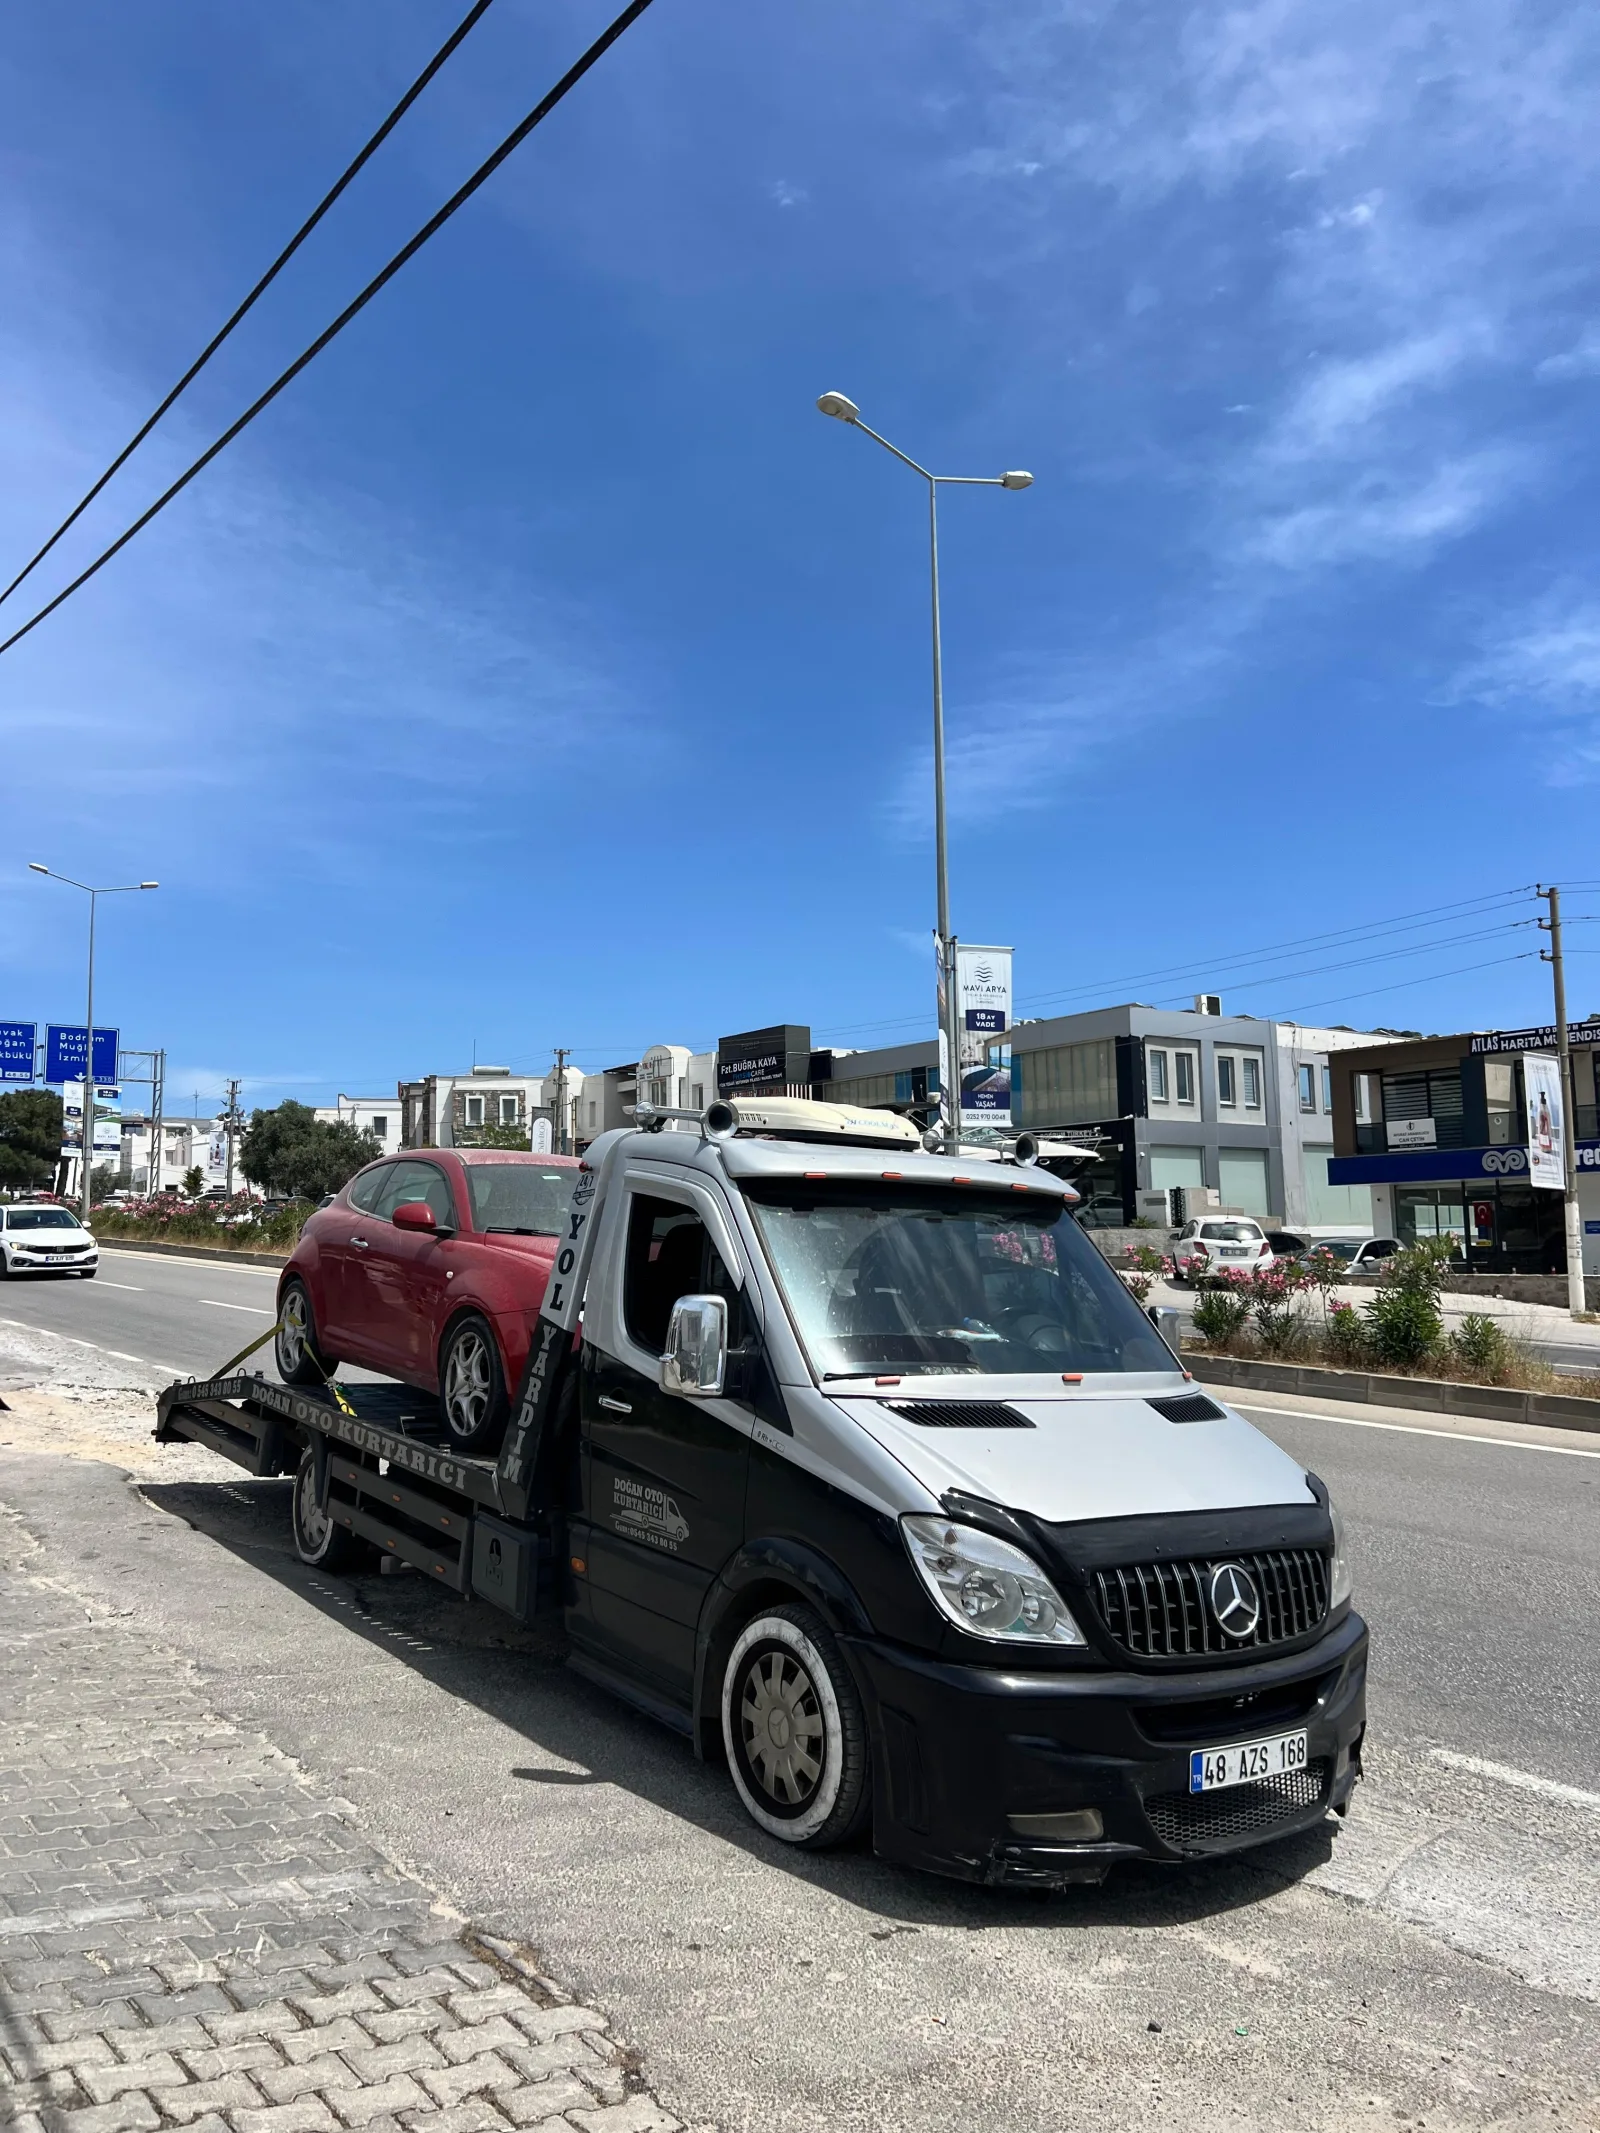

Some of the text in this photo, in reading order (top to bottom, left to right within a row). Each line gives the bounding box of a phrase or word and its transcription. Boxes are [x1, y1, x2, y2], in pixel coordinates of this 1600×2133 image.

[986, 985, 1007, 993] ARYA
[975, 1020, 996, 1028] VADE
[976, 1012, 986, 1020] 18
[0, 1029, 23, 1037] vak
[1538, 1024, 1579, 1035] BODUM
[1471, 1036, 1499, 1053] ATLAS
[758, 1056, 777, 1068] KAYA
[974, 1100, 997, 1109] YAŞAM
[549, 1213, 586, 1311] YOL
[209, 1382, 222, 1397] 343
[222, 1380, 232, 1395] 80
[232, 1379, 242, 1394] 55
[503, 1325, 557, 1484] YARDIM
[252, 1383, 466, 1490] DOĞAN OTO KURTARICI
[614, 1477, 663, 1504] DOĞAN OTO
[613, 1491, 663, 1519] KURTARICI
[646, 1532, 659, 1545] 343
[659, 1537, 668, 1548] 80
[668, 1540, 678, 1551] 55
[1204, 1736, 1306, 1786] 48 AZS 168
[1192, 1774, 1202, 1784] TR
